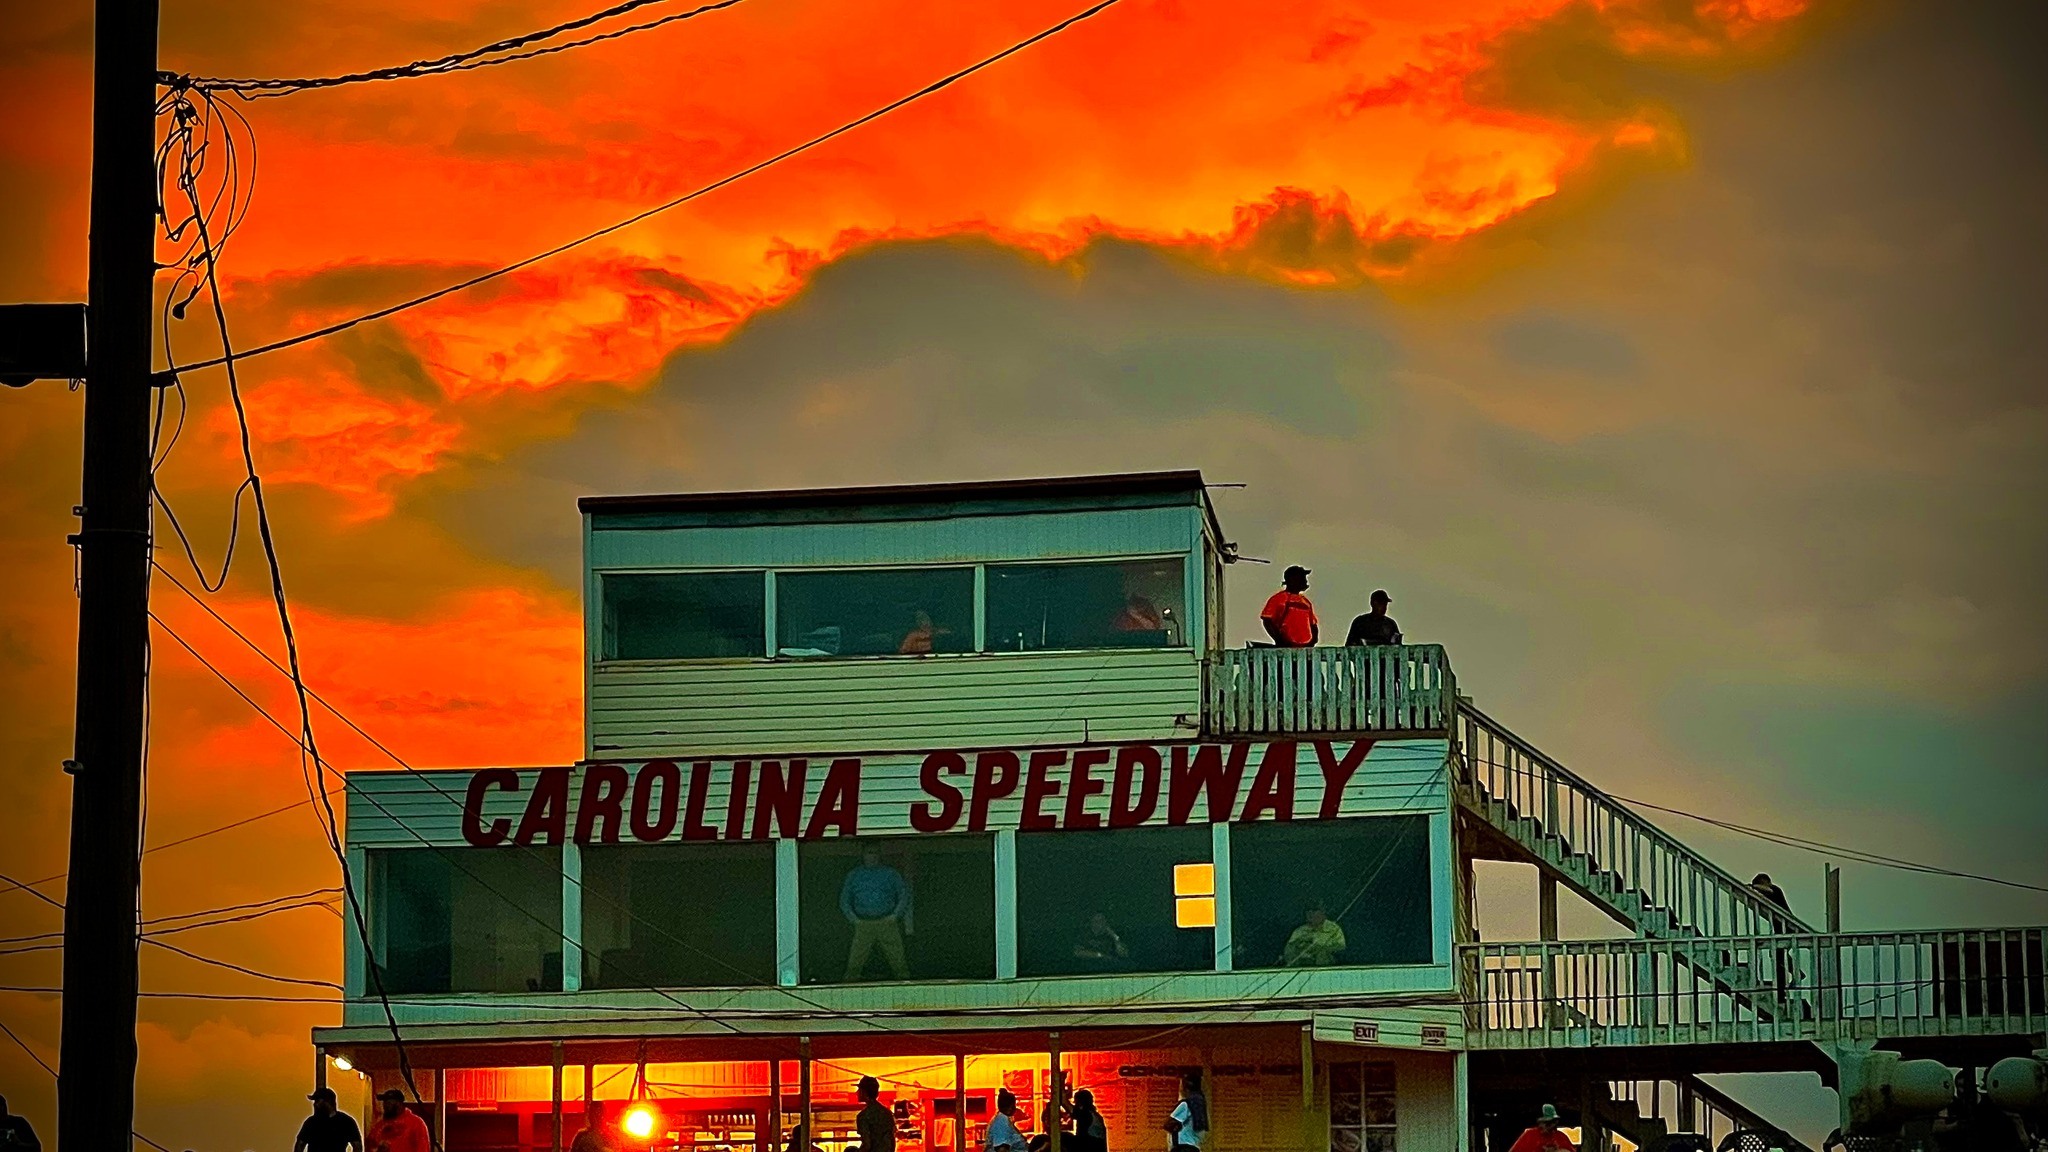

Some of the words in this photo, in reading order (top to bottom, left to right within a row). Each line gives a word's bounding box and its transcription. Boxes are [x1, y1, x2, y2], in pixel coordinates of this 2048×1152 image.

[461, 758, 861, 847] CAROLINA
[909, 739, 1374, 832] SPEEDWAY
[1355, 1026, 1377, 1038] EXIT
[1423, 1030, 1445, 1038] ENTER
